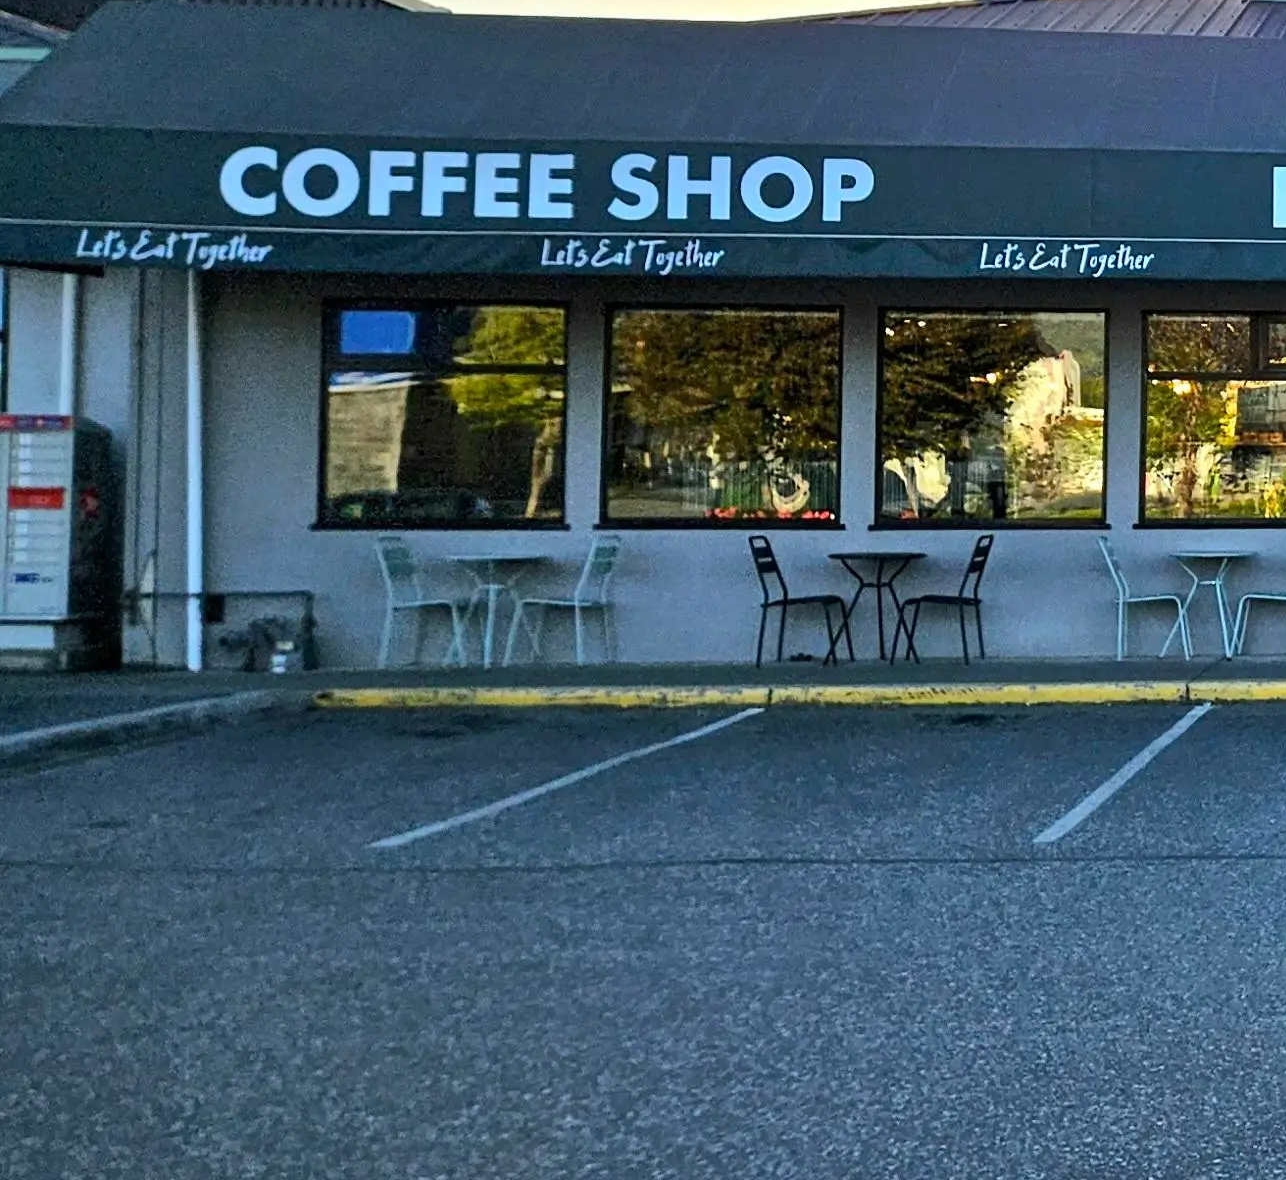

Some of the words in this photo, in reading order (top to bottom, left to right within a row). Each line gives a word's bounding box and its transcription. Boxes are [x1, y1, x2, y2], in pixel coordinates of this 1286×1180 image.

[219, 146, 575, 219] COFFEE
[607, 153, 875, 223] SHOP
[130, 229, 180, 260] Eat
[181, 232, 274, 270] Together
[541, 237, 589, 268] Let's
[590, 238, 636, 268] Eat
[638, 239, 725, 276] Together
[980, 242, 1025, 270] Let's
[1029, 242, 1071, 270] Eat
[1074, 243, 1155, 278] Together
